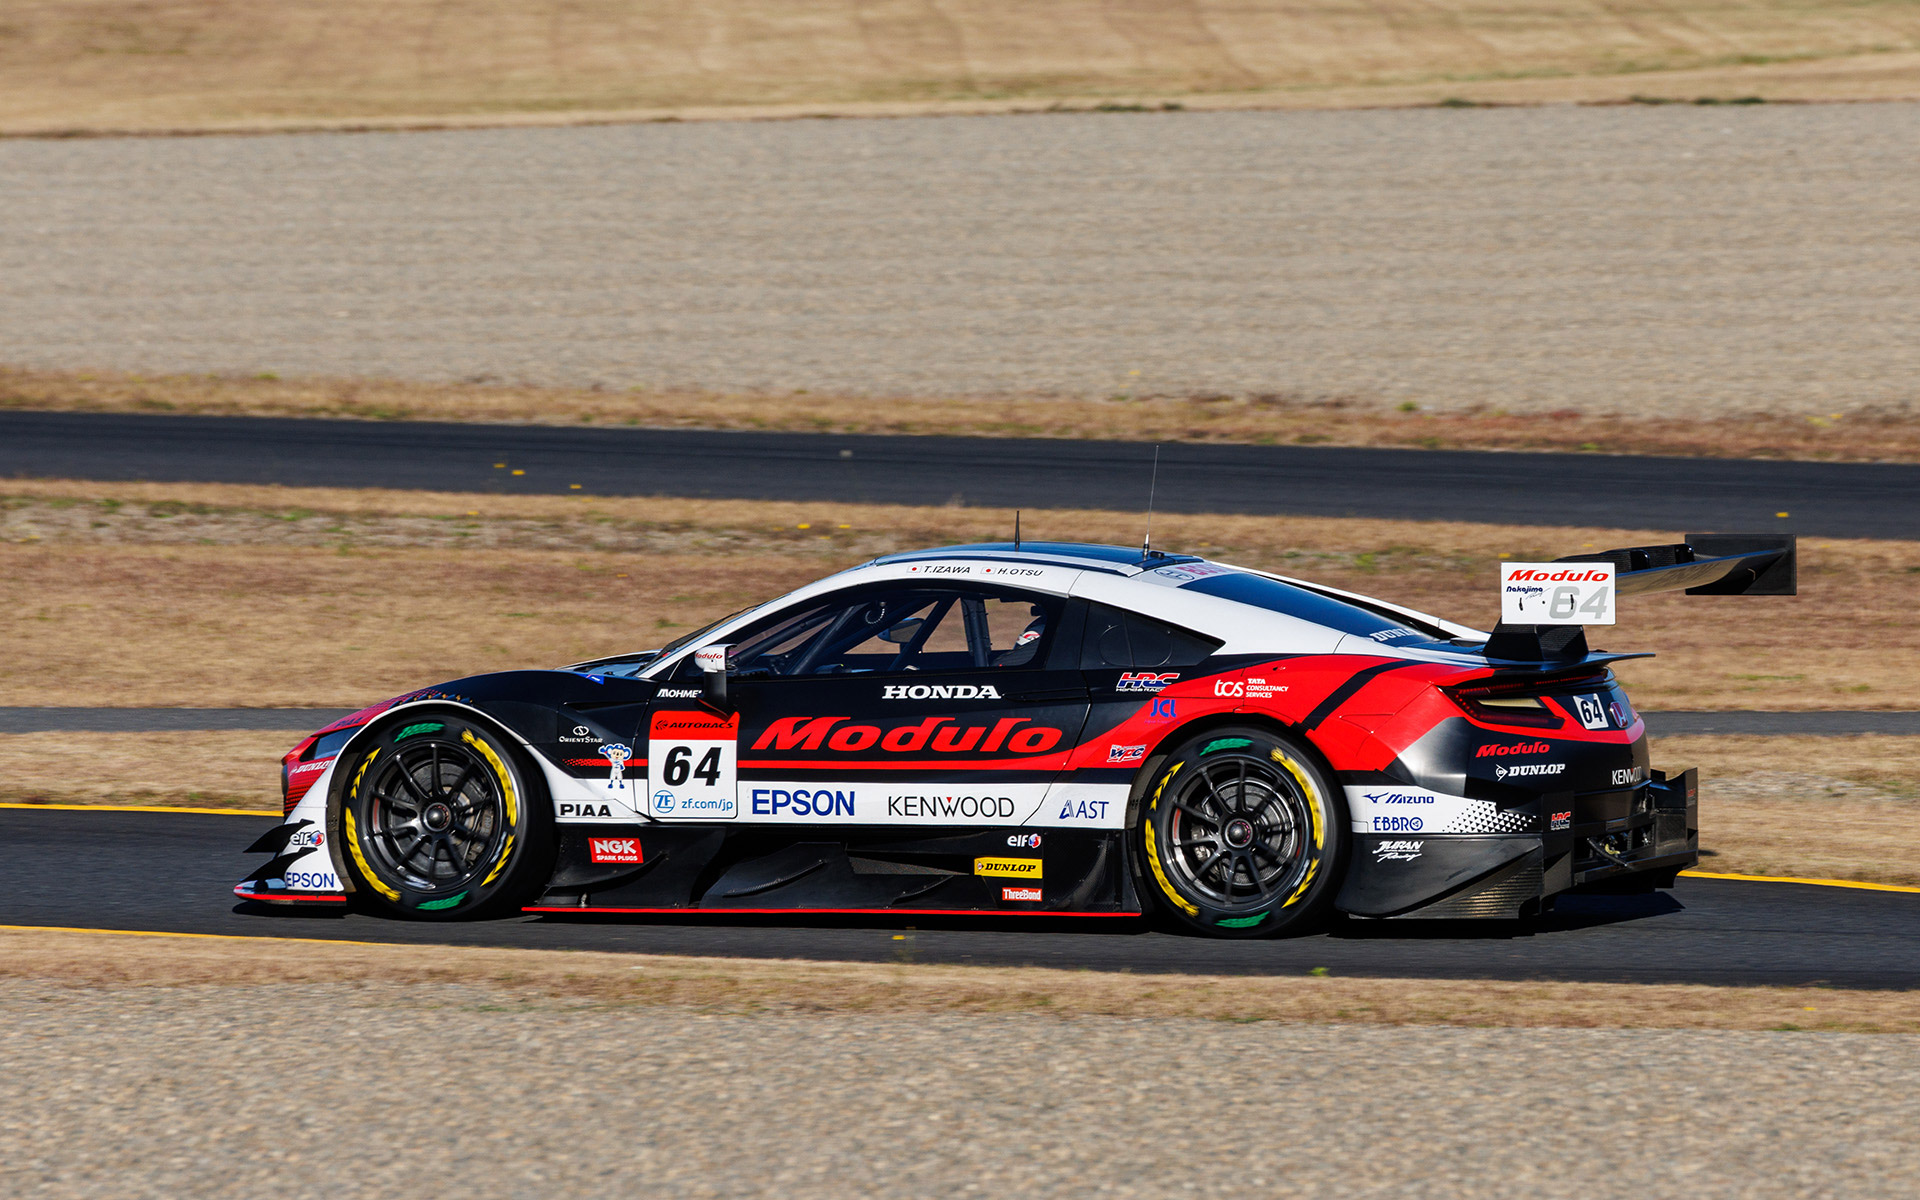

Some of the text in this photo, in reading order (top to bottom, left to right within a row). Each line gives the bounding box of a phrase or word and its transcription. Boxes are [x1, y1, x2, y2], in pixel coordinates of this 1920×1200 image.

[923, 565, 971, 574] T.IZAWA
[997, 567, 1044, 577] H.OTSU
[1507, 569, 1610, 582] Modulo
[1548, 586, 1609, 620] 64
[1116, 672, 1181, 689] HRC
[881, 685, 1002, 700] HONDA
[1214, 679, 1245, 698] tcs
[1245, 691, 1273, 699] SERVICES
[1580, 700, 1603, 724] 64
[751, 716, 1063, 752] Modulo
[1475, 741, 1551, 758] Modulo
[662, 745, 723, 787] 64
[1508, 763, 1566, 777] DUNLOP
[560, 803, 612, 817] PIAA
[681, 798, 734, 812] zf.com/jp
[751, 789, 855, 817] EPSON
[888, 795, 1016, 818] KENWOOD
[1372, 816, 1424, 831] EBBRO
[290, 831, 312, 846] elf
[1007, 834, 1029, 848] elf
[593, 839, 637, 854] NGK
[1372, 840, 1425, 854] JURAN
[985, 863, 1037, 872] DUNLOP
[285, 871, 335, 888] EPSON
[1002, 888, 1041, 900] ThreeBond
